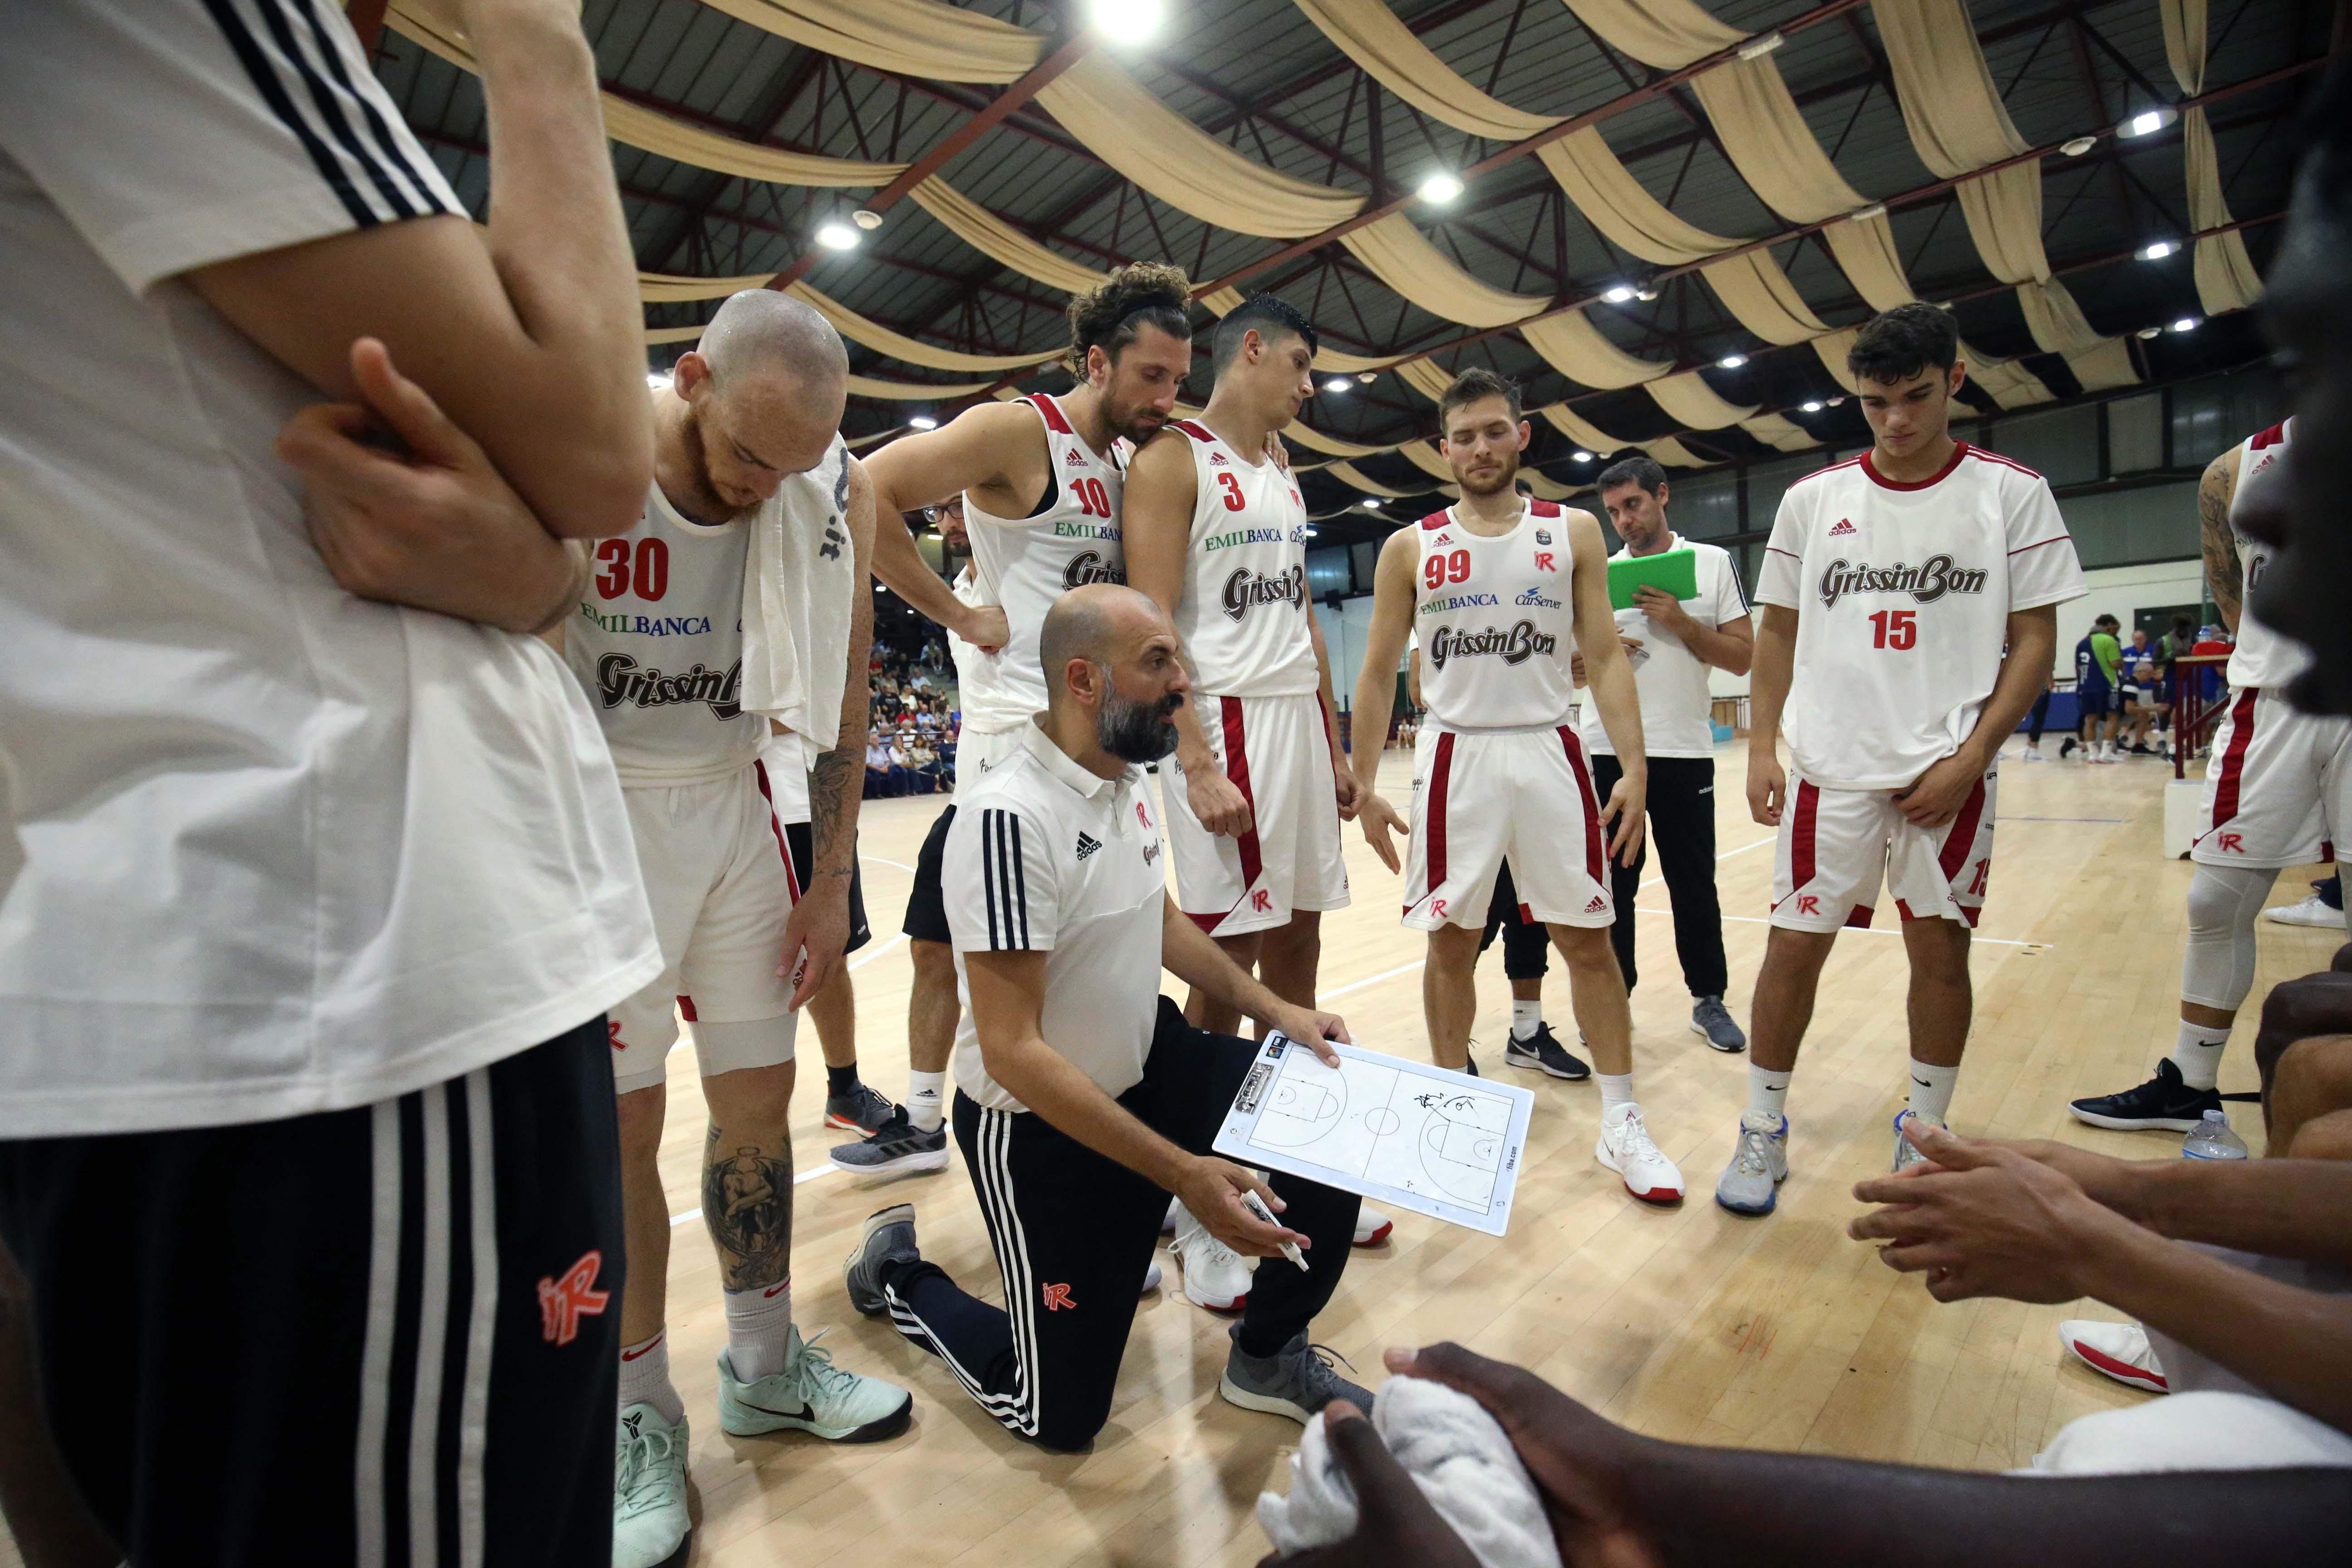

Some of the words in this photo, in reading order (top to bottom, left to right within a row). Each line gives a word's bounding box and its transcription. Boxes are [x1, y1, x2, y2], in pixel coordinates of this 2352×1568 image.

[1069, 478, 1112, 518] 10
[1218, 472, 1245, 512] 3
[1054, 522, 1122, 543] EMILBAN
[1205, 528, 1283, 552] EMILBANCA
[1828, 527, 1857, 537] adidas
[595, 537, 669, 602] 30
[1425, 549, 1470, 590] 99
[1819, 554, 1989, 611] GrissinBon
[581, 602, 712, 637] EMILBANCA
[1421, 593, 1499, 615] EMILBANCA
[1431, 619, 1557, 673] GrissinBon
[1868, 610, 1917, 650] 15
[1077, 840, 1102, 861] adidas
[1584, 903, 1607, 913] adidas
